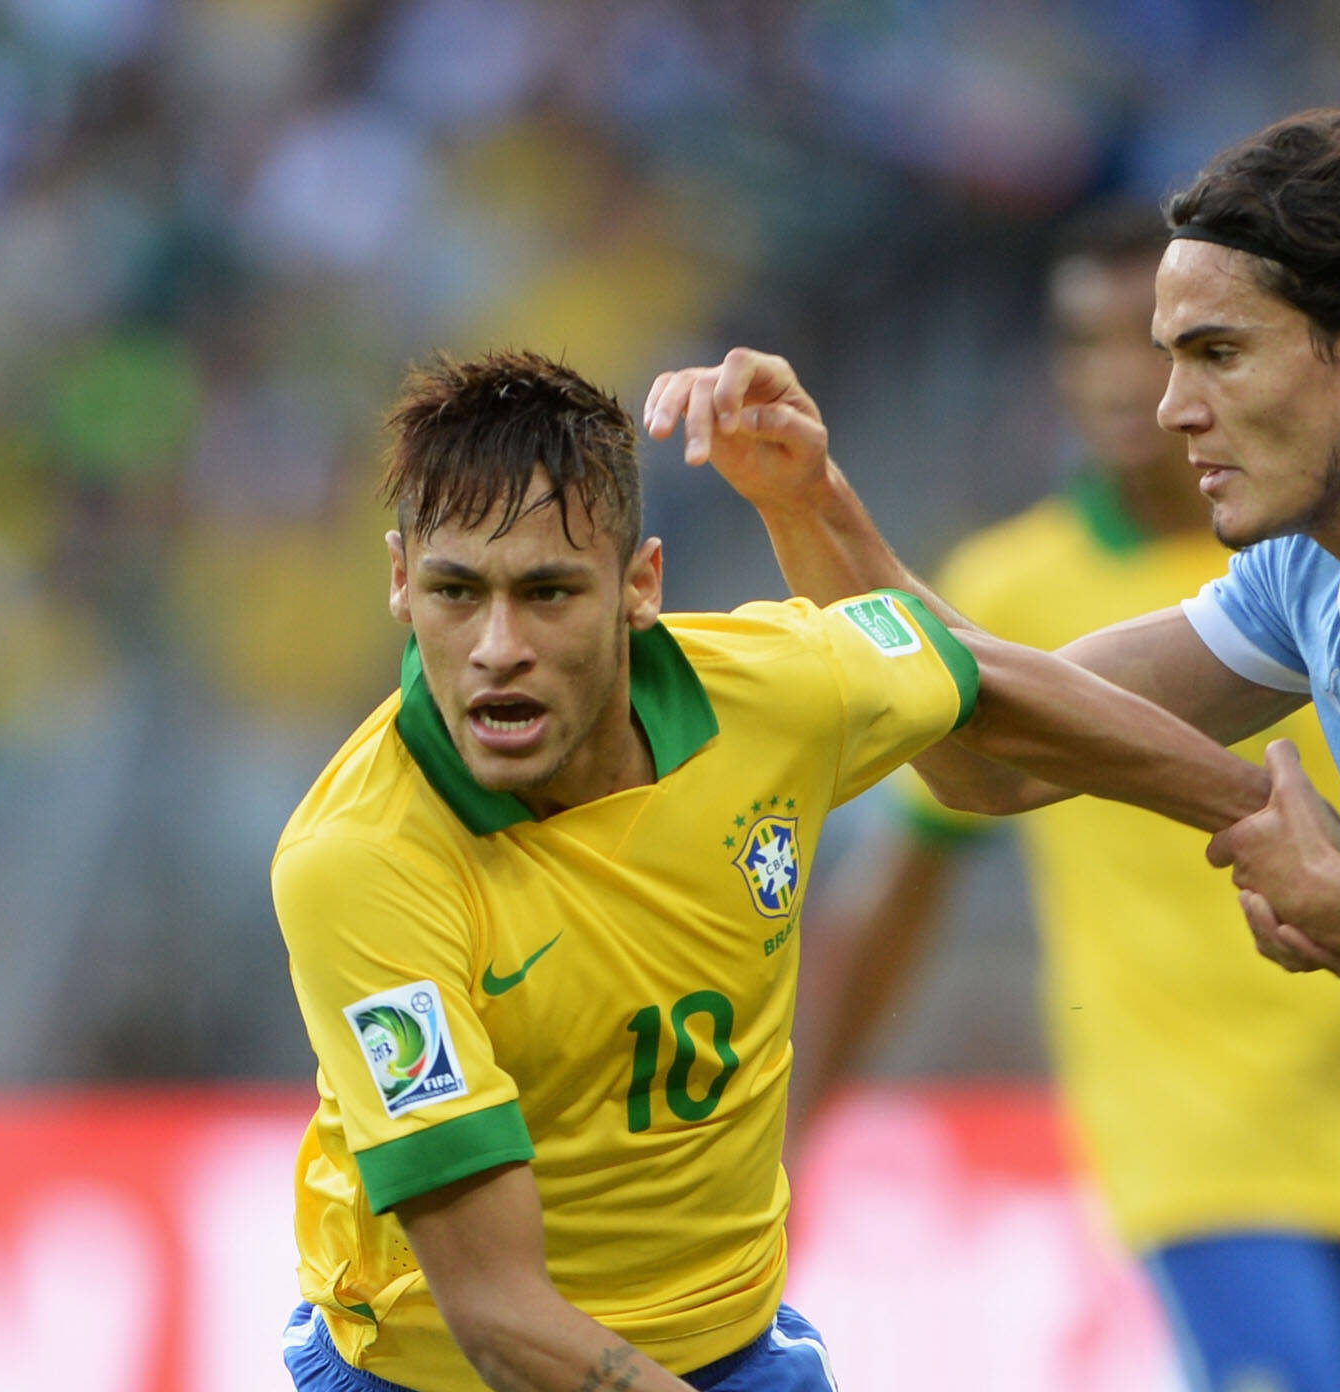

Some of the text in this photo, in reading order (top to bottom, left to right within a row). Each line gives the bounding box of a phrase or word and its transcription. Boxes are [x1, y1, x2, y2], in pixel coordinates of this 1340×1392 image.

[765, 853, 787, 876] CBF
[627, 989, 739, 1134] 10
[422, 1073, 456, 1092] FIFA
